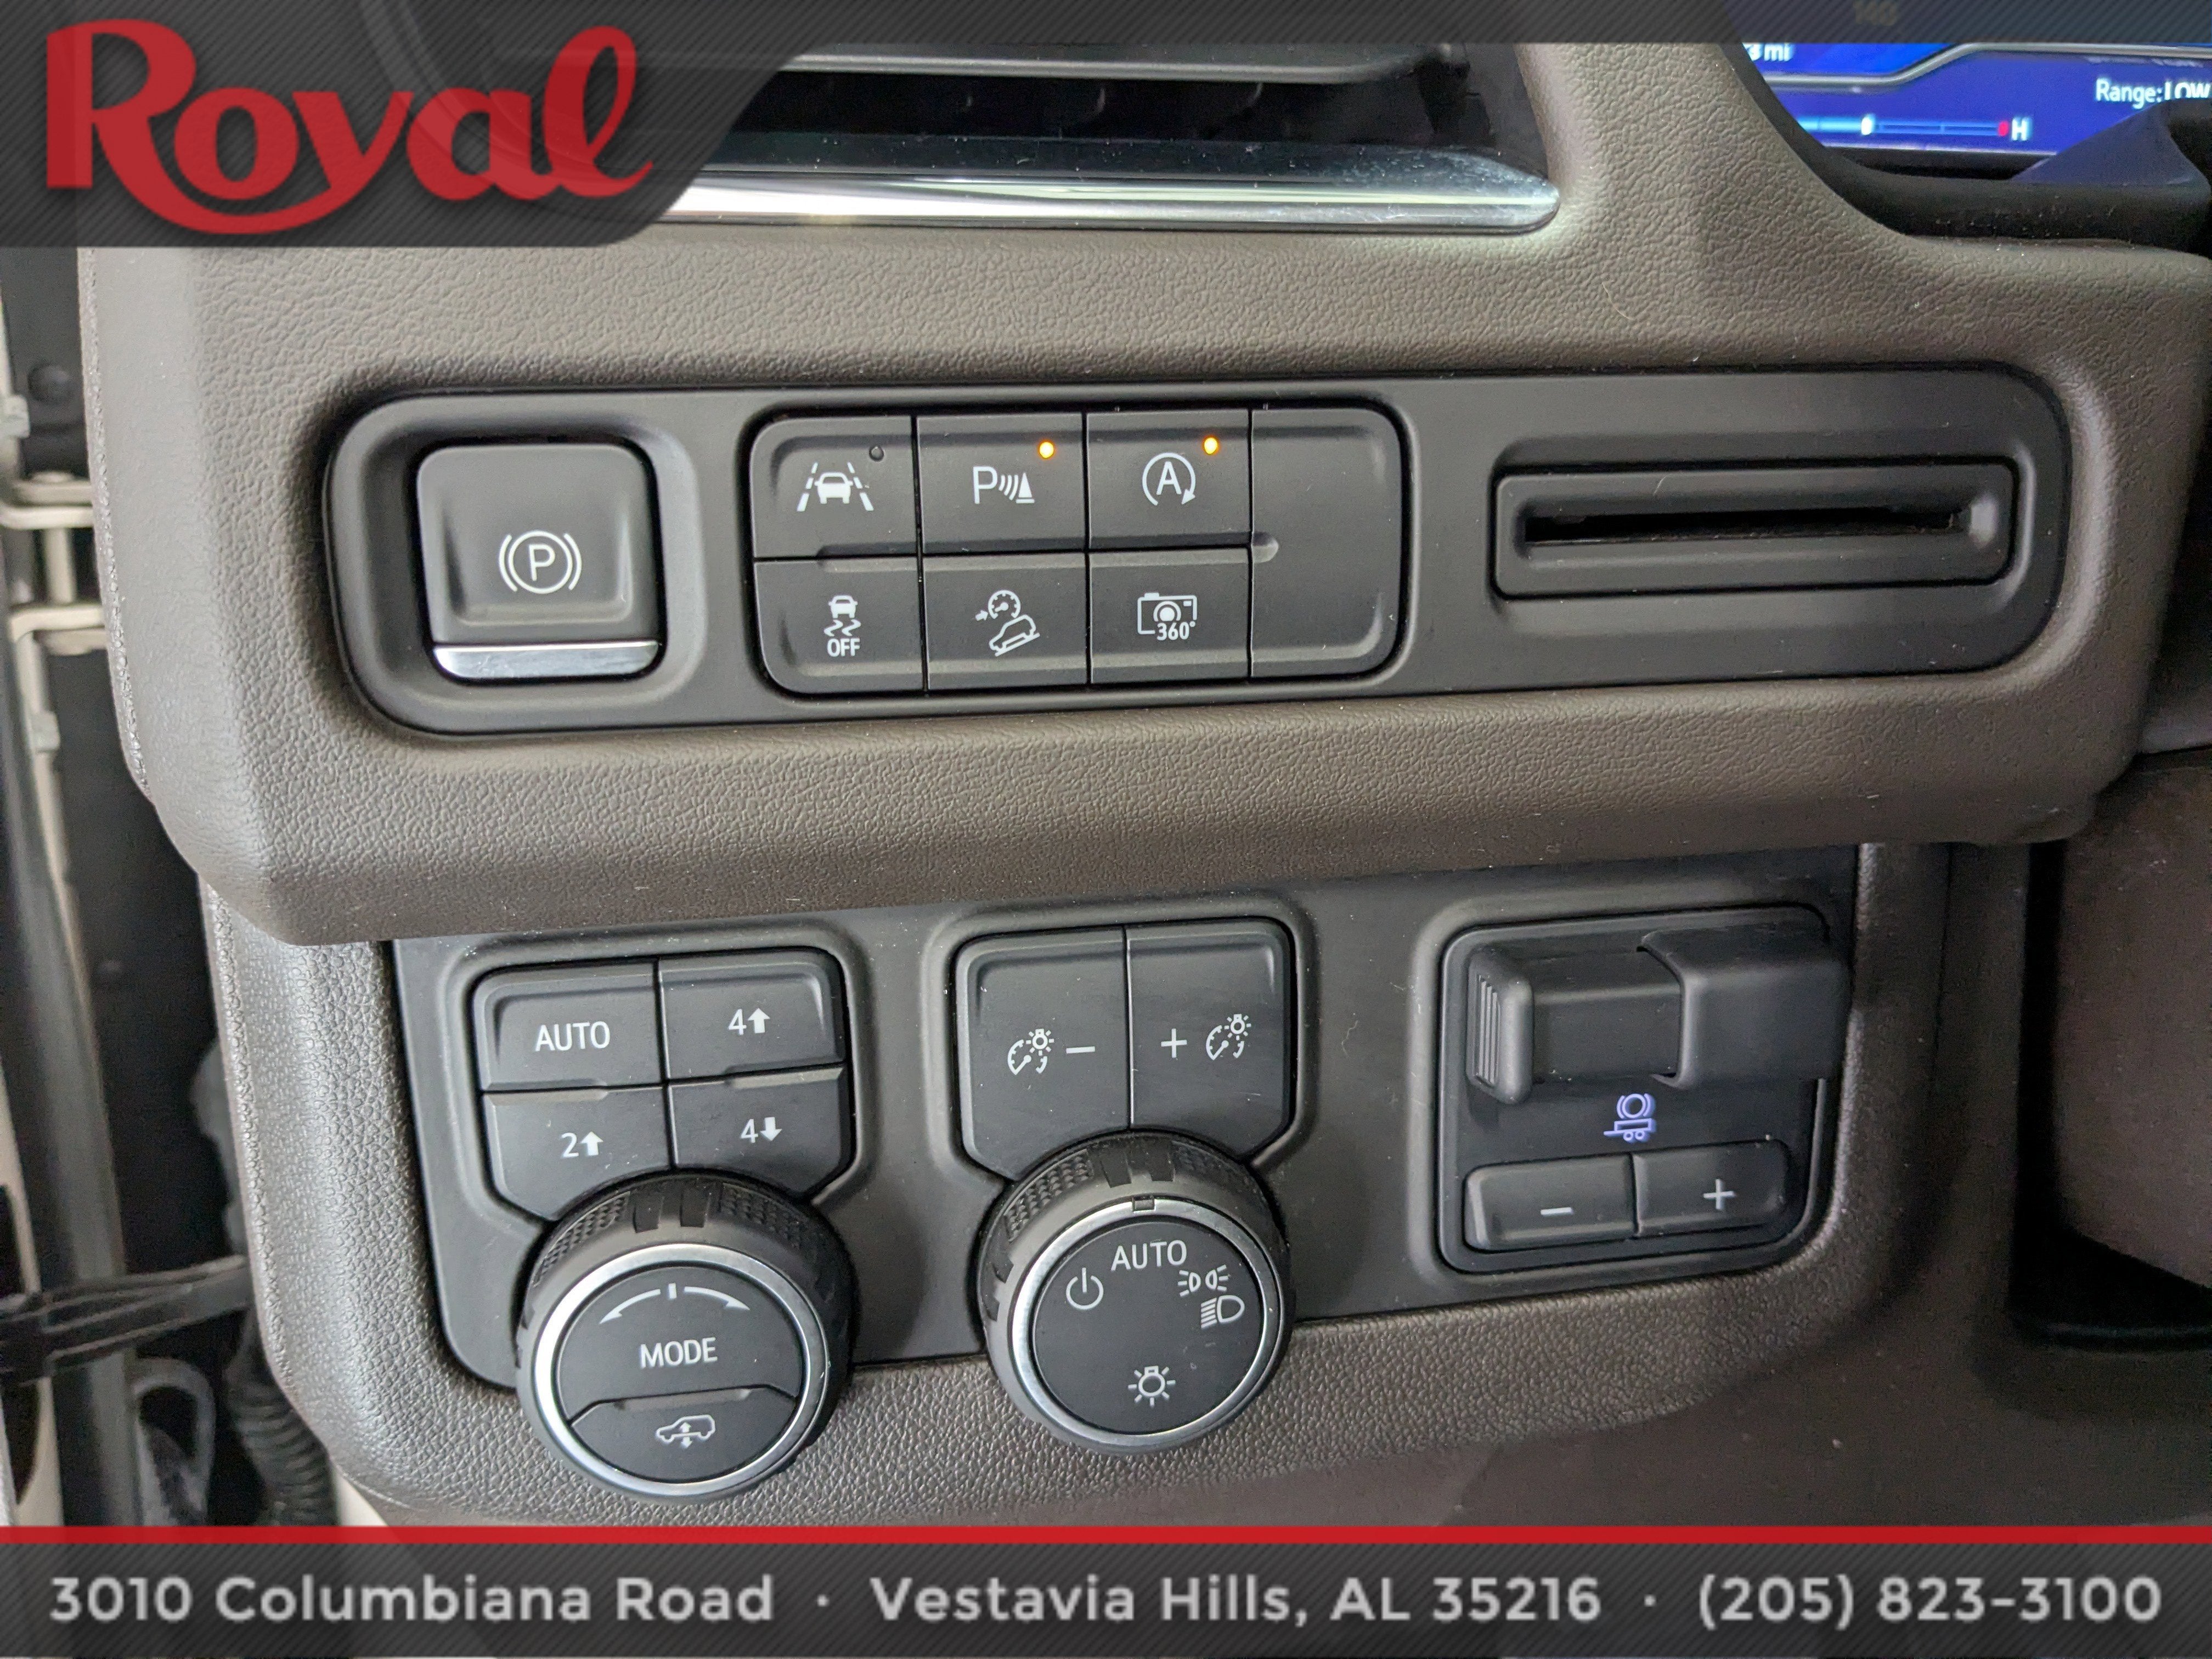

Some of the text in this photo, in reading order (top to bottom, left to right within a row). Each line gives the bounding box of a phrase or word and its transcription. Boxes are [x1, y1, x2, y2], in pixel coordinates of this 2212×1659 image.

[2011, 116, 2031, 142] H
[973, 465, 998, 504] P
[1156, 461, 1182, 495] A
[528, 543, 556, 582] P
[827, 638, 860, 657] OFF
[535, 1020, 611, 1052] AUTO
[1110, 1238, 1188, 1272] AUTO
[640, 1336, 718, 1368] MODE
